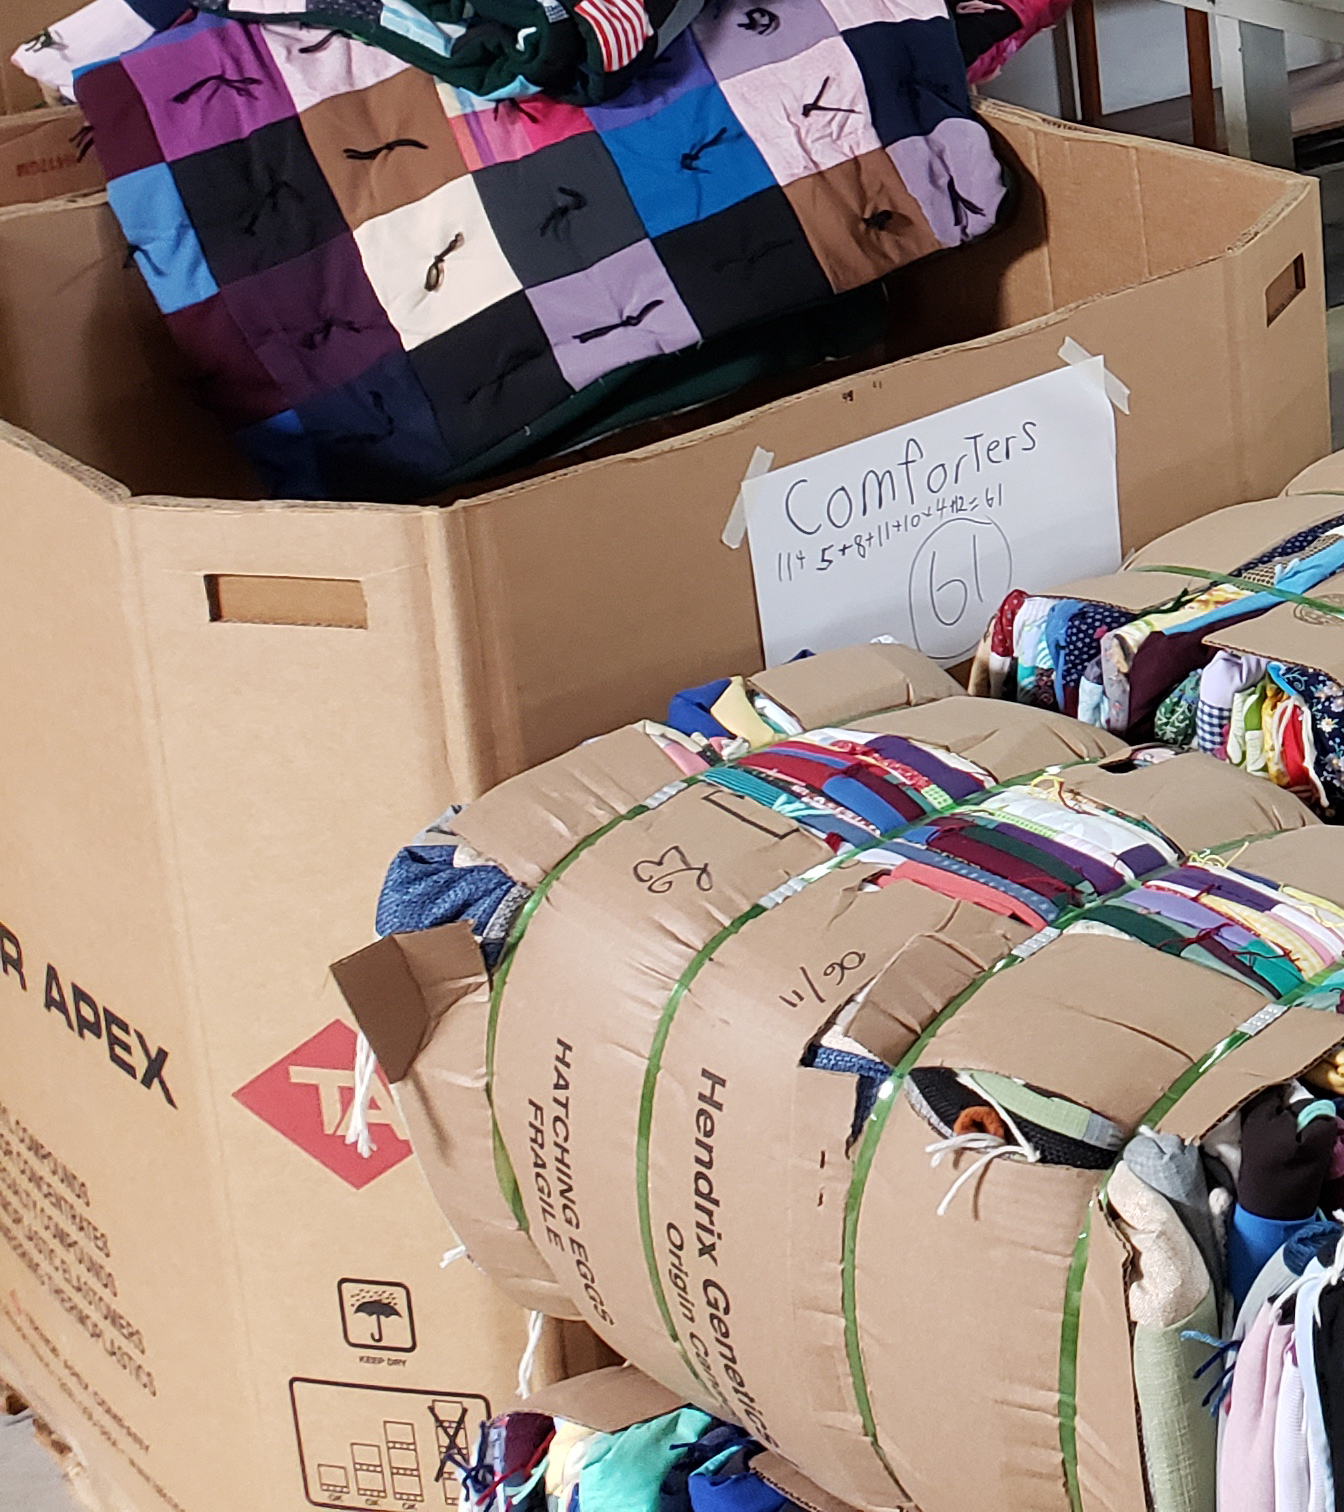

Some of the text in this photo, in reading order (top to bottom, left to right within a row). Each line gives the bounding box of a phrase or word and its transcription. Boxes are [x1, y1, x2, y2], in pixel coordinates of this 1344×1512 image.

[928, 533, 984, 626] 61
[43, 962, 179, 1111] APEX
[527, 1097, 566, 1253] FRAGILE
[551, 1036, 616, 1327] HATCHING EGGS
[665, 1220, 696, 1324] Origin
[692, 1067, 781, 1451] Hendrix Genetics
